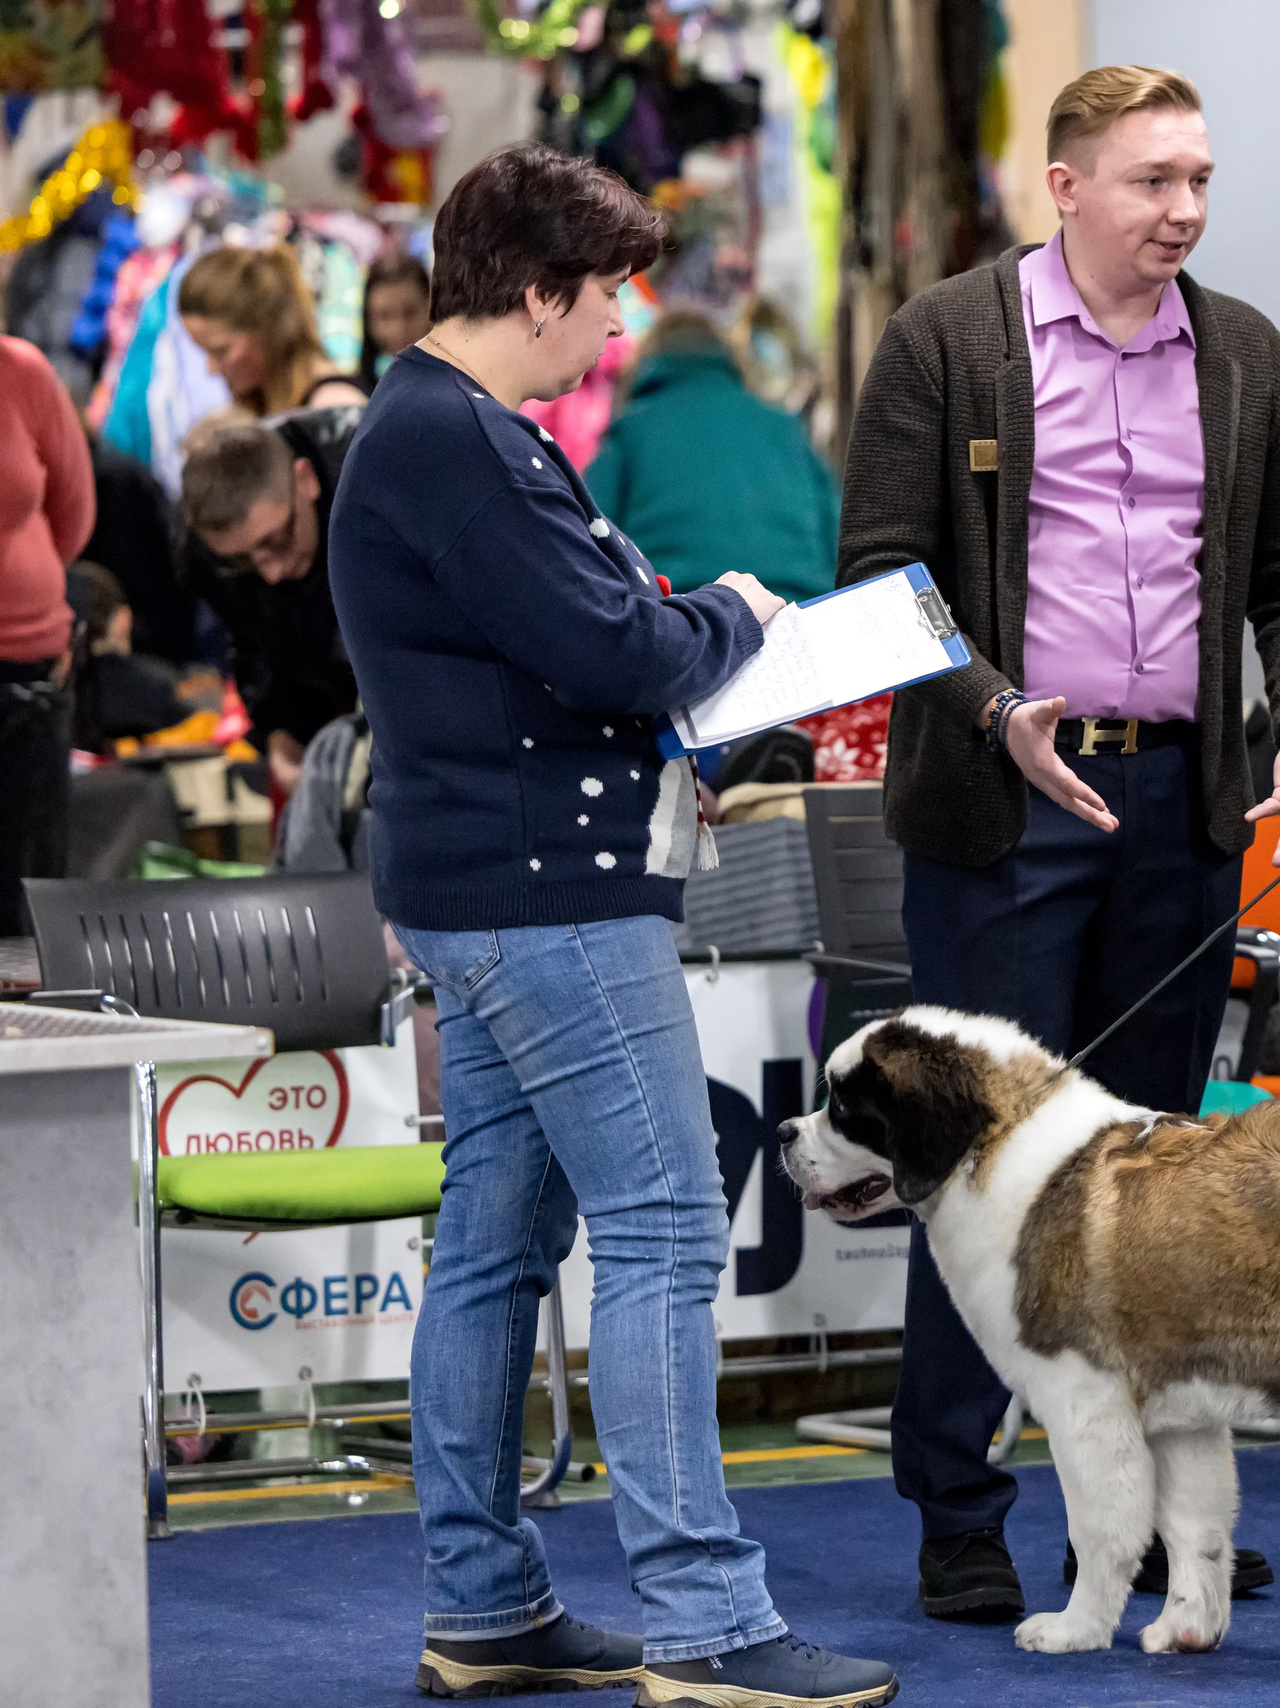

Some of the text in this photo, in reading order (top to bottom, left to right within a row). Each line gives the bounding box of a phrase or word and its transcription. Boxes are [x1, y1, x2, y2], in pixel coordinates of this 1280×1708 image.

[268, 1084, 327, 1111] ЭТО
[186, 1128, 314, 1155] ЛЮБОВЬ
[229, 1271, 413, 1330] СФЕРА
